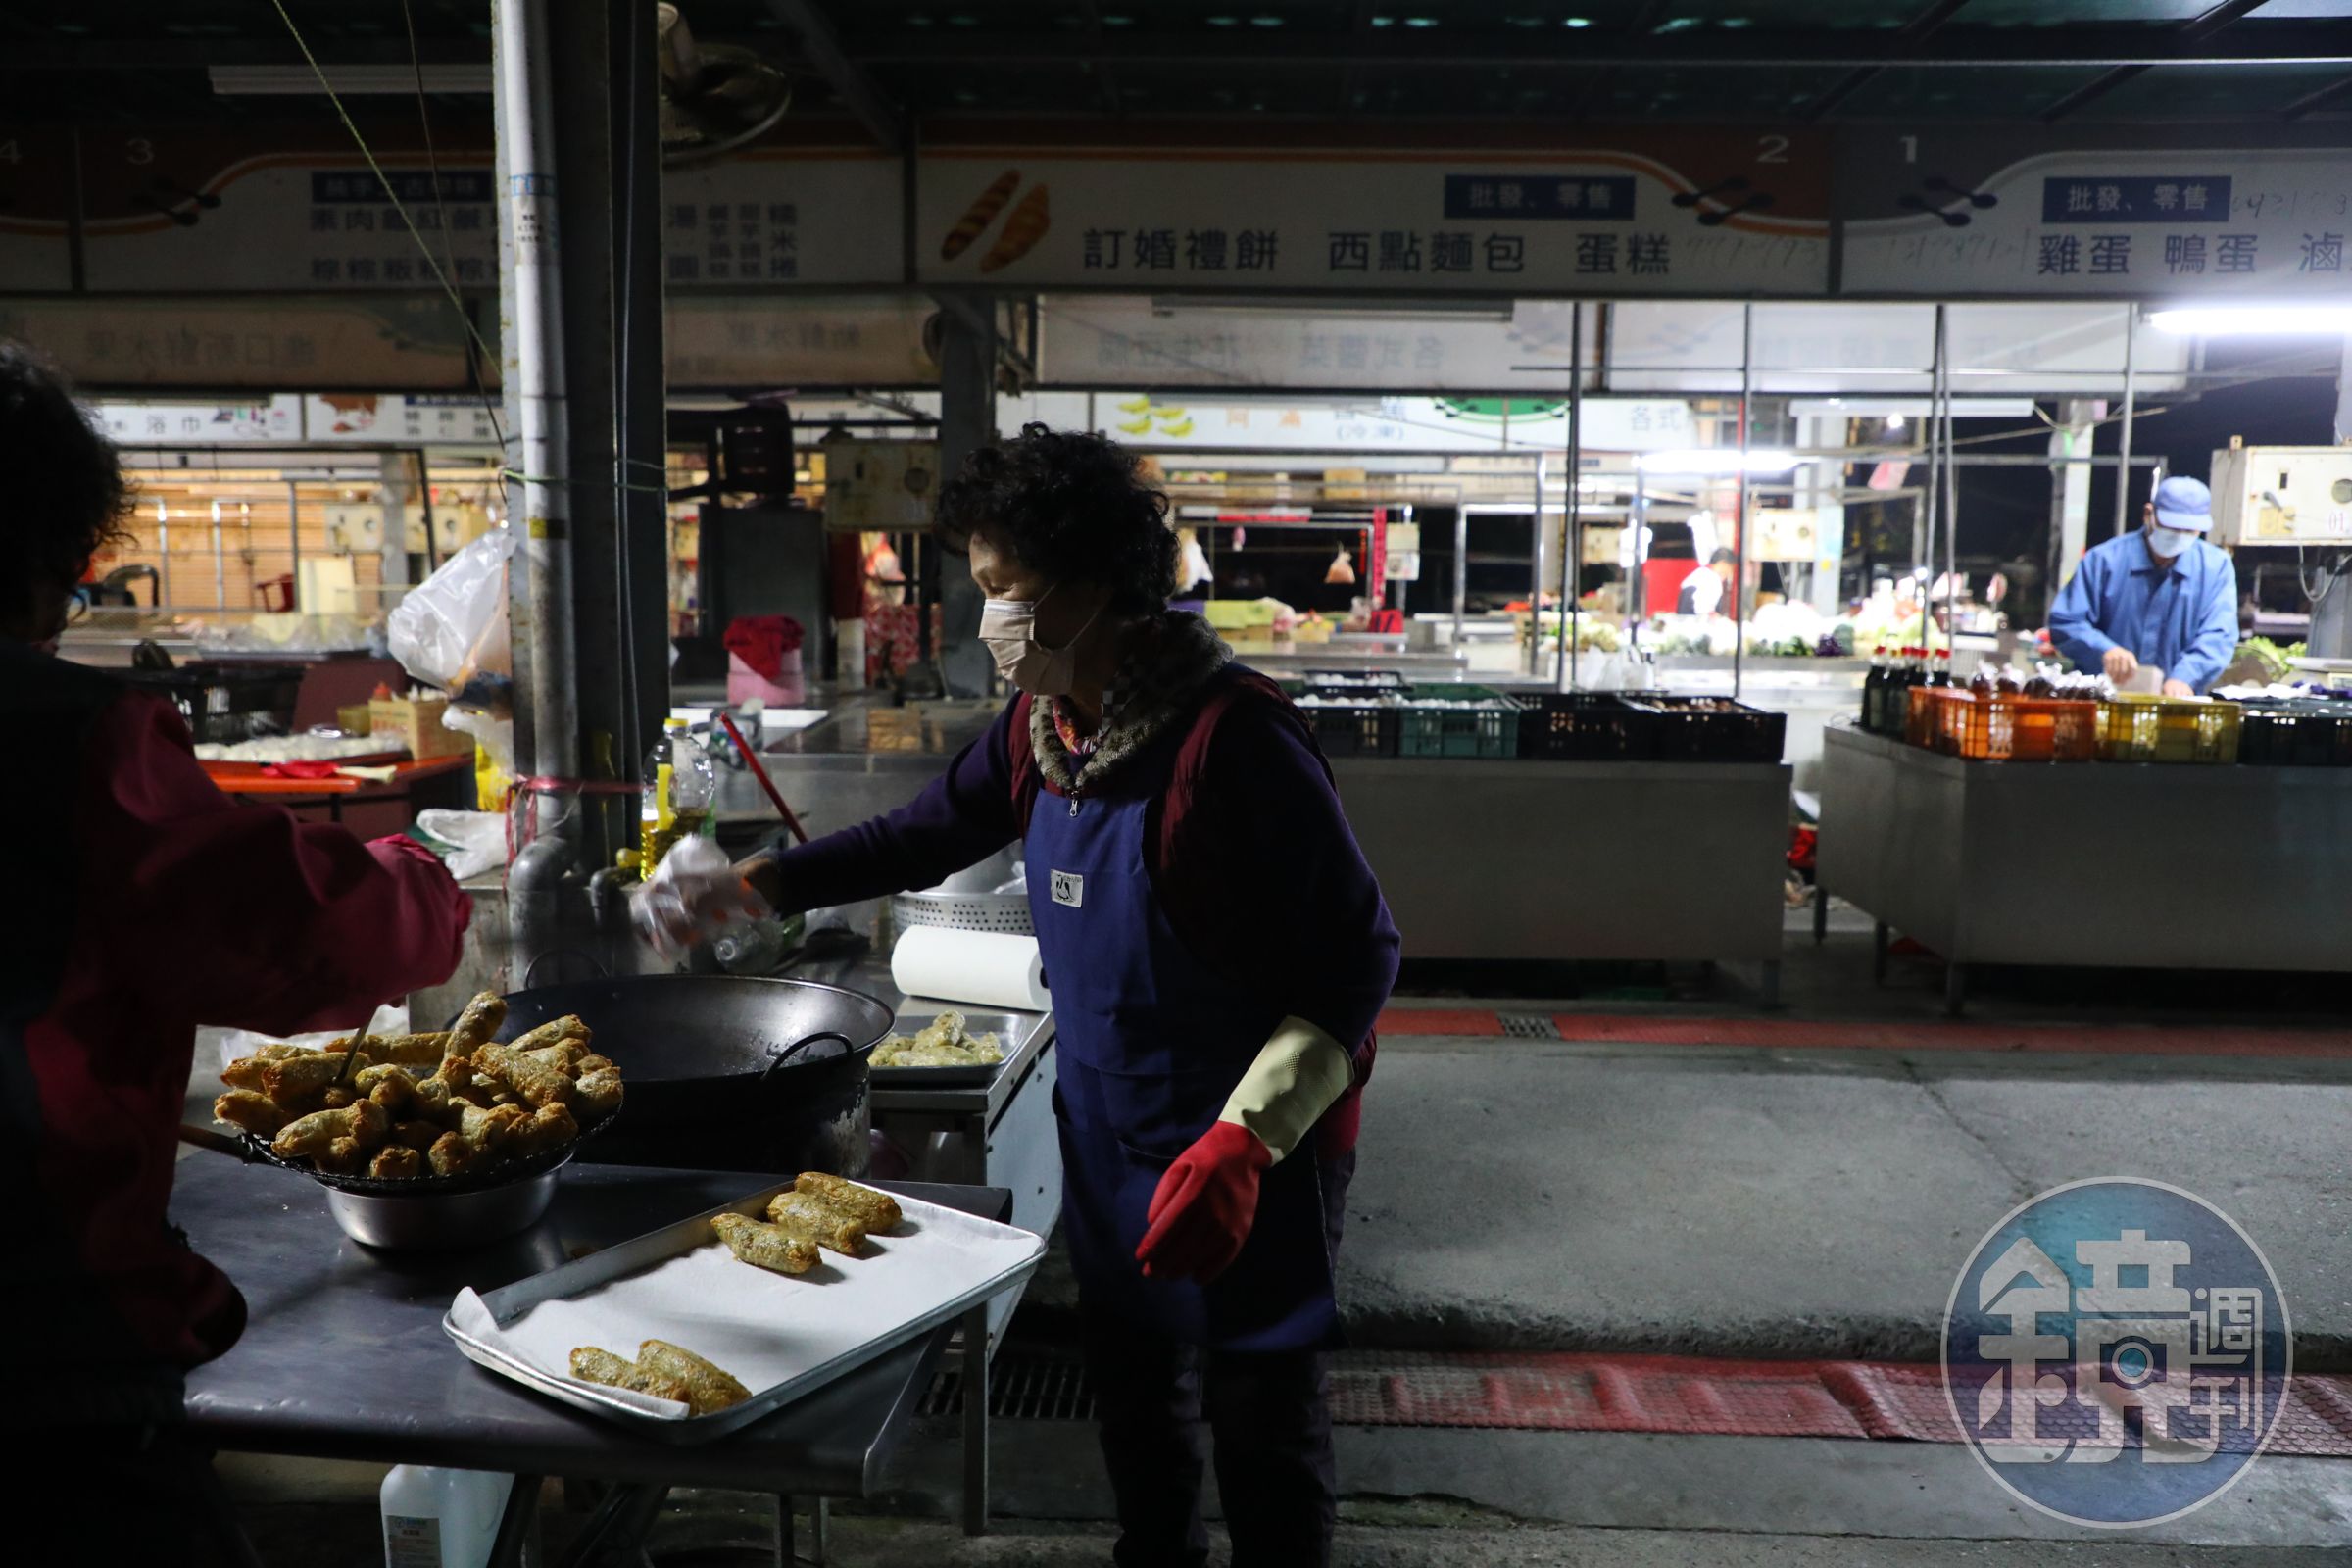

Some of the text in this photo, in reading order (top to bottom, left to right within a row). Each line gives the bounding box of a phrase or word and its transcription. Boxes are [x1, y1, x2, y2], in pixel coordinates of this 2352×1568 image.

[127, 137, 155, 165] 3
[1757, 135, 1789, 163] 2
[1899, 135, 1918, 163] 1
[1082, 228, 1278, 271] 訂婚禮餅
[1328, 231, 1525, 274] 西點麵包
[1574, 232, 1671, 274] 蛋糕
[2037, 233, 2132, 275] 雞蛋
[2163, 233, 2259, 274] 鴨蛋
